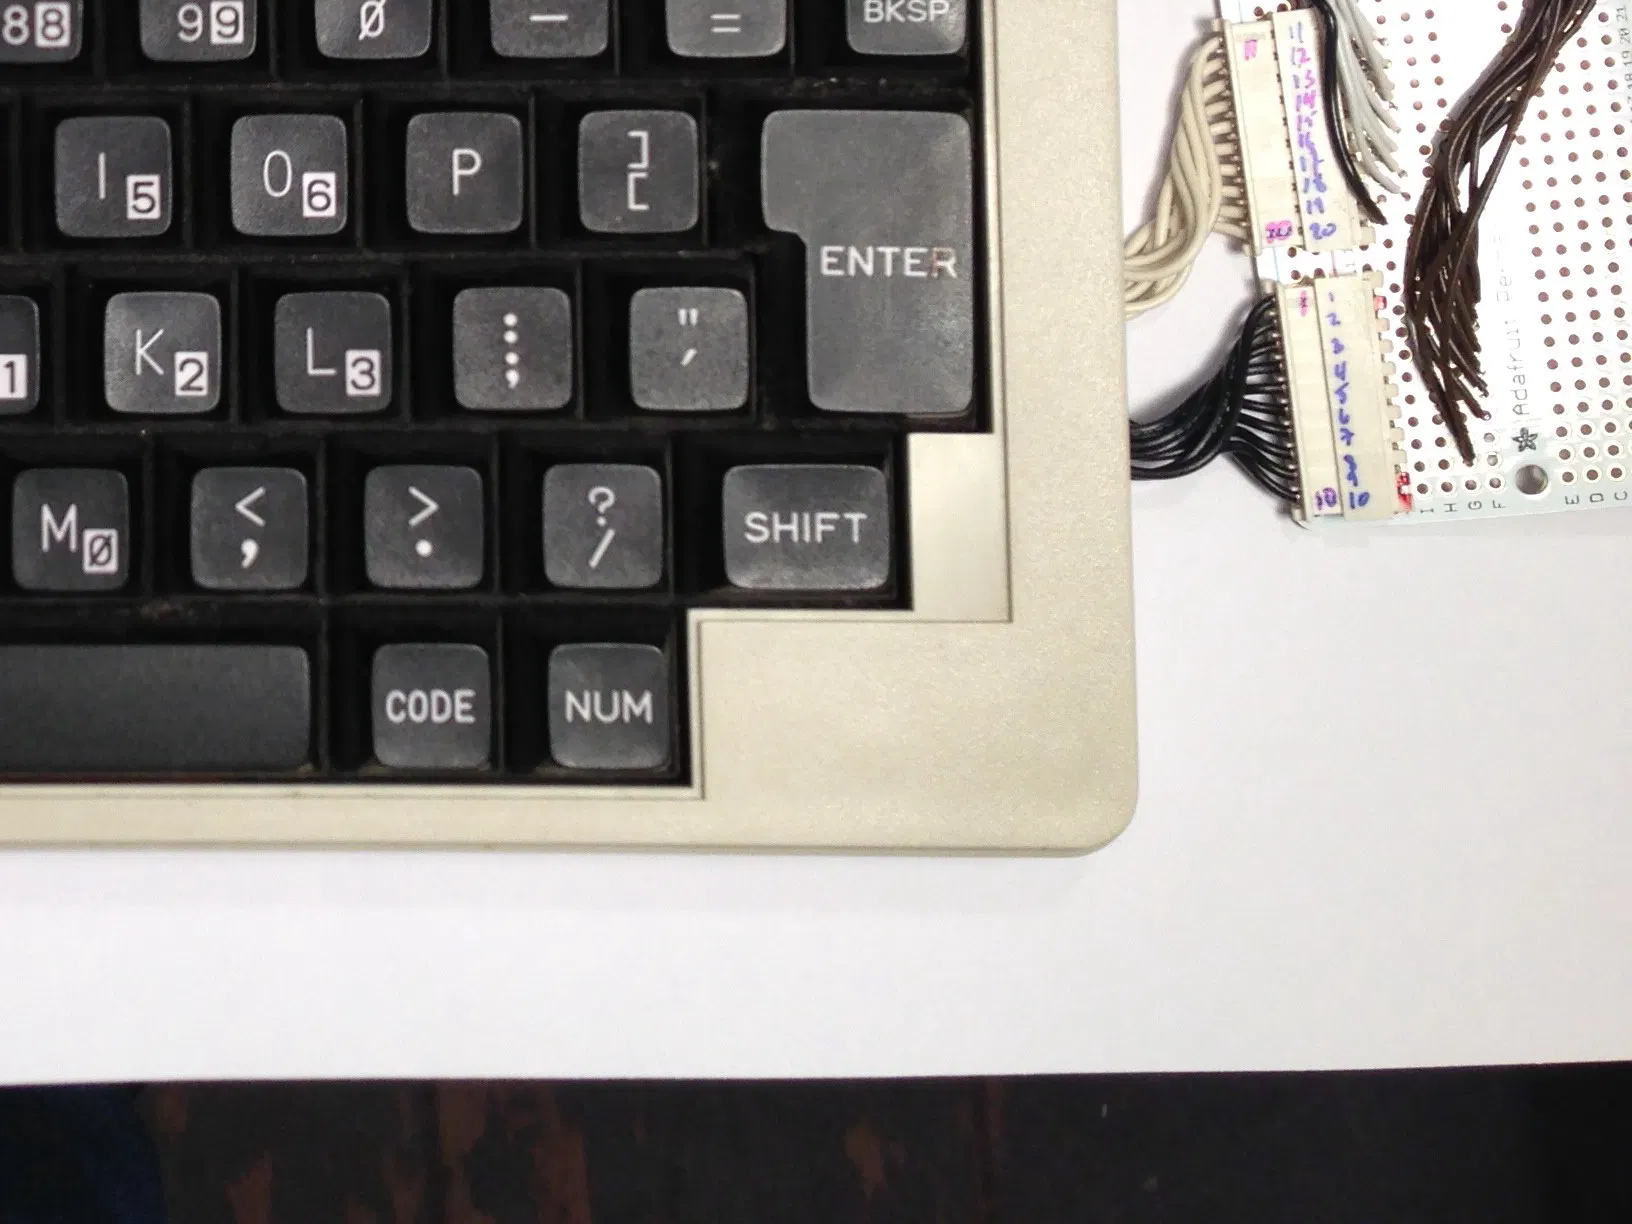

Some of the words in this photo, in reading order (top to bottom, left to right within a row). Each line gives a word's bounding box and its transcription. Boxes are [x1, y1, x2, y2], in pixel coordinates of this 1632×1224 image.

[2, 5, 30, 45] 8
[40, 7, 64, 40] 8
[177, 2, 204, 43] 9
[215, 5, 238, 40] 9
[452, 148, 482, 196] P
[132, 181, 155, 214] 5
[308, 179, 331, 213] 6
[820, 245, 957, 277] ENTER
[135, 328, 164, 376] K
[305, 327, 337, 377] L
[0, 362, 18, 394] 1
[180, 359, 203, 391] 2
[351, 358, 375, 391] 3
[41, 504, 77, 552] M
[744, 511, 868, 544] SHIFT
[385, 689, 475, 724] CODE
[565, 690, 653, 723] NUM
